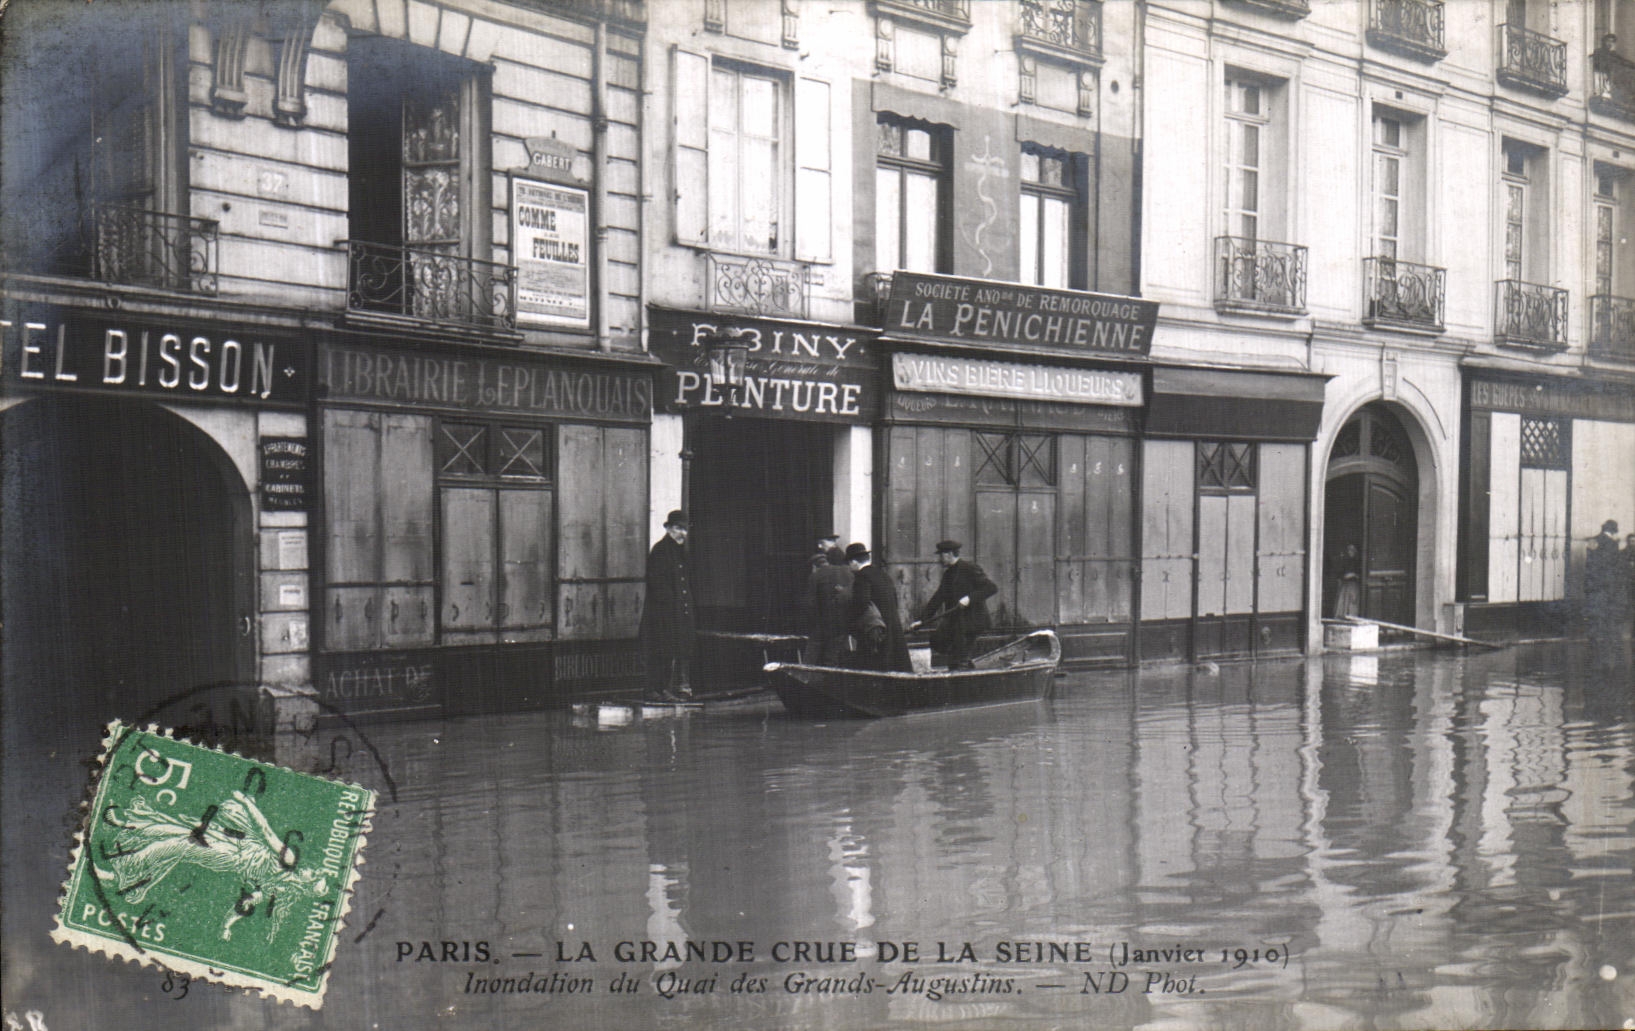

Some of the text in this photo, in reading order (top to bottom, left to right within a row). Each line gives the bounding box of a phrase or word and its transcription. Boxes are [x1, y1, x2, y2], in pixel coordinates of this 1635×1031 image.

[533, 152, 572, 171] GABERT
[261, 171, 283, 193] 37
[519, 205, 556, 231] COMME
[533, 237, 579, 264] FEUILLES
[1016, 293, 1036, 309] DE
[1039, 294, 1140, 322] REMORQUAGE
[900, 299, 1145, 350] LA PÉNICHIENNE
[103, 328, 275, 399] BISSON
[911, 360, 959, 385] VINS
[1030, 371, 1124, 398] LIQUEURS
[326, 351, 650, 416] LIBRAIRIE LEPLANQUAIS
[326, 667, 396, 699] ACHAT
[82, 903, 166, 942] POSTES
